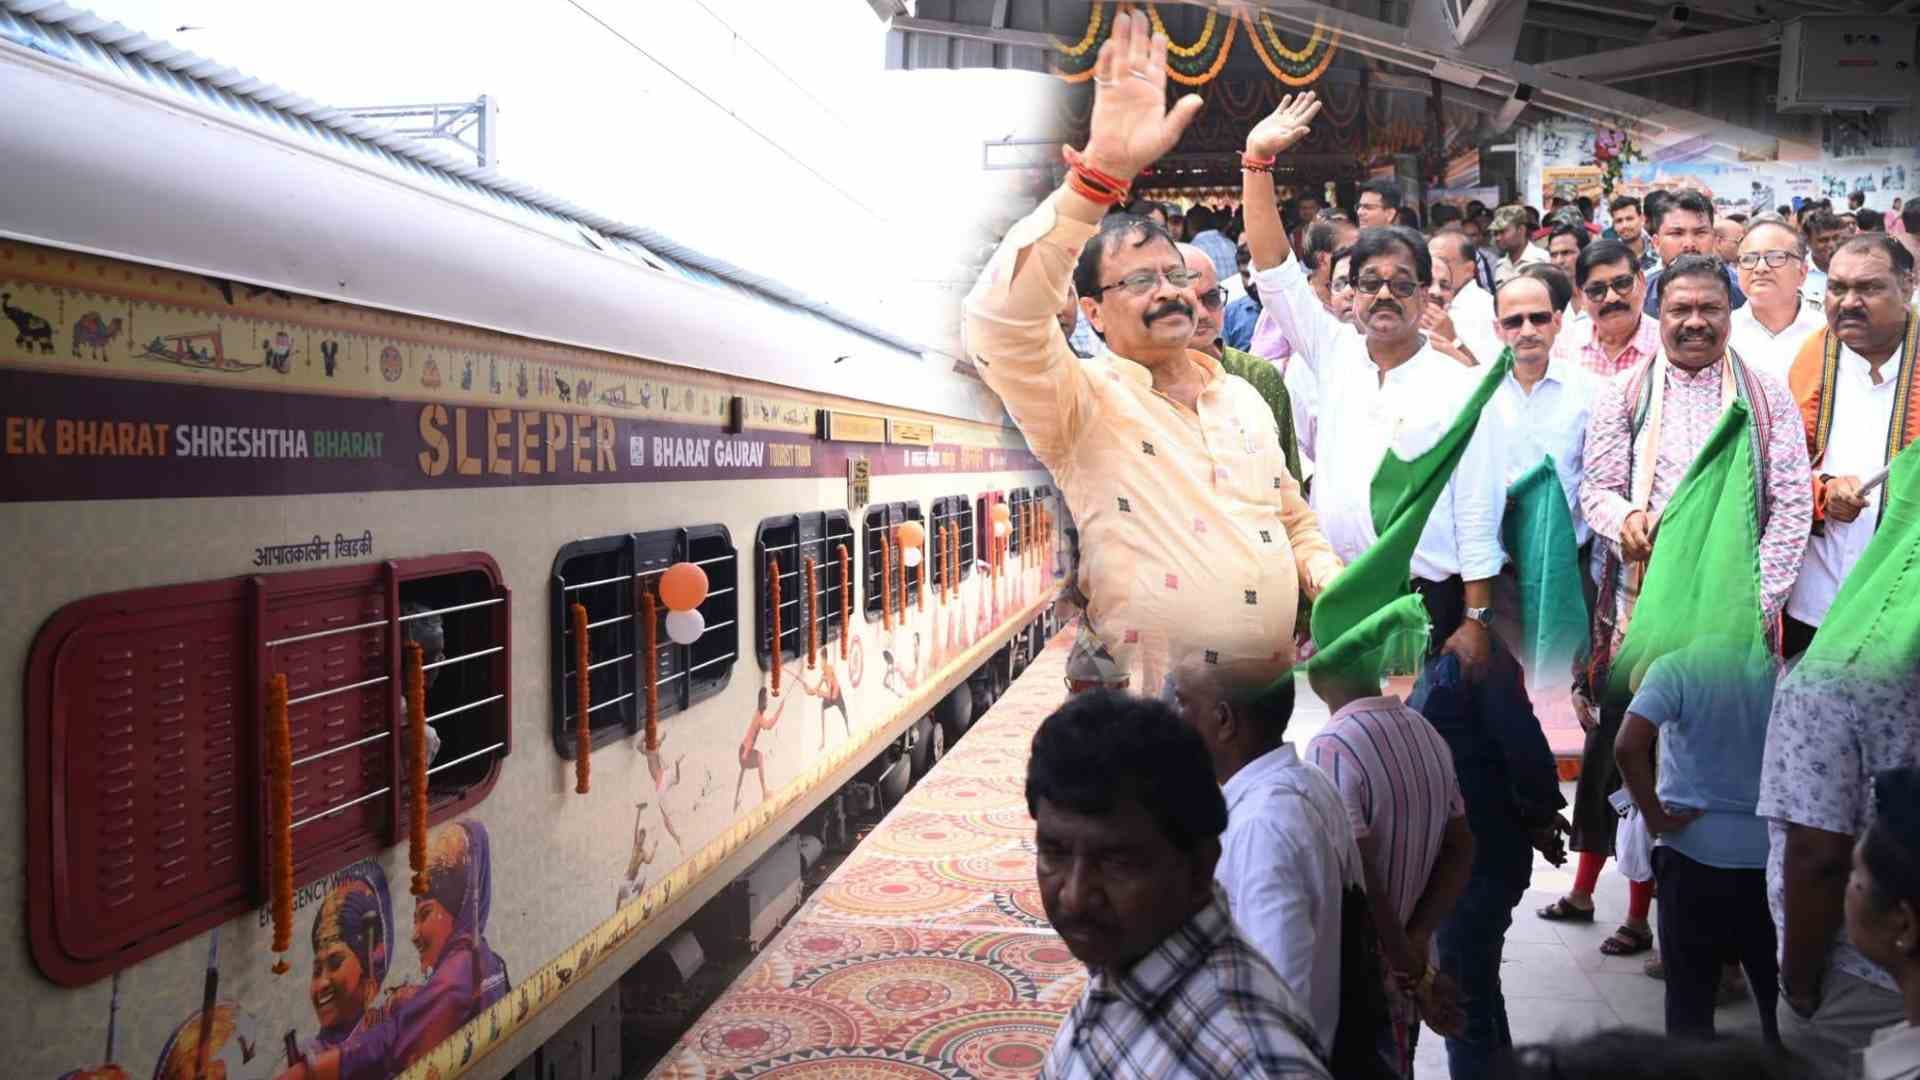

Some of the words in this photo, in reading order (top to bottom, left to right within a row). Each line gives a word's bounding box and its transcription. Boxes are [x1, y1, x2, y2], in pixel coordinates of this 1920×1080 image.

[6, 416, 46, 456] EK
[56, 420, 169, 456] BHARAT
[175, 424, 309, 458] SHRESHTHA
[313, 432, 384, 457] BHARAT
[418, 403, 617, 477] SLEEPER
[652, 436, 711, 467] BHARAT
[714, 440, 765, 467] GAURAV
[253, 534, 331, 566] आपातकालीन
